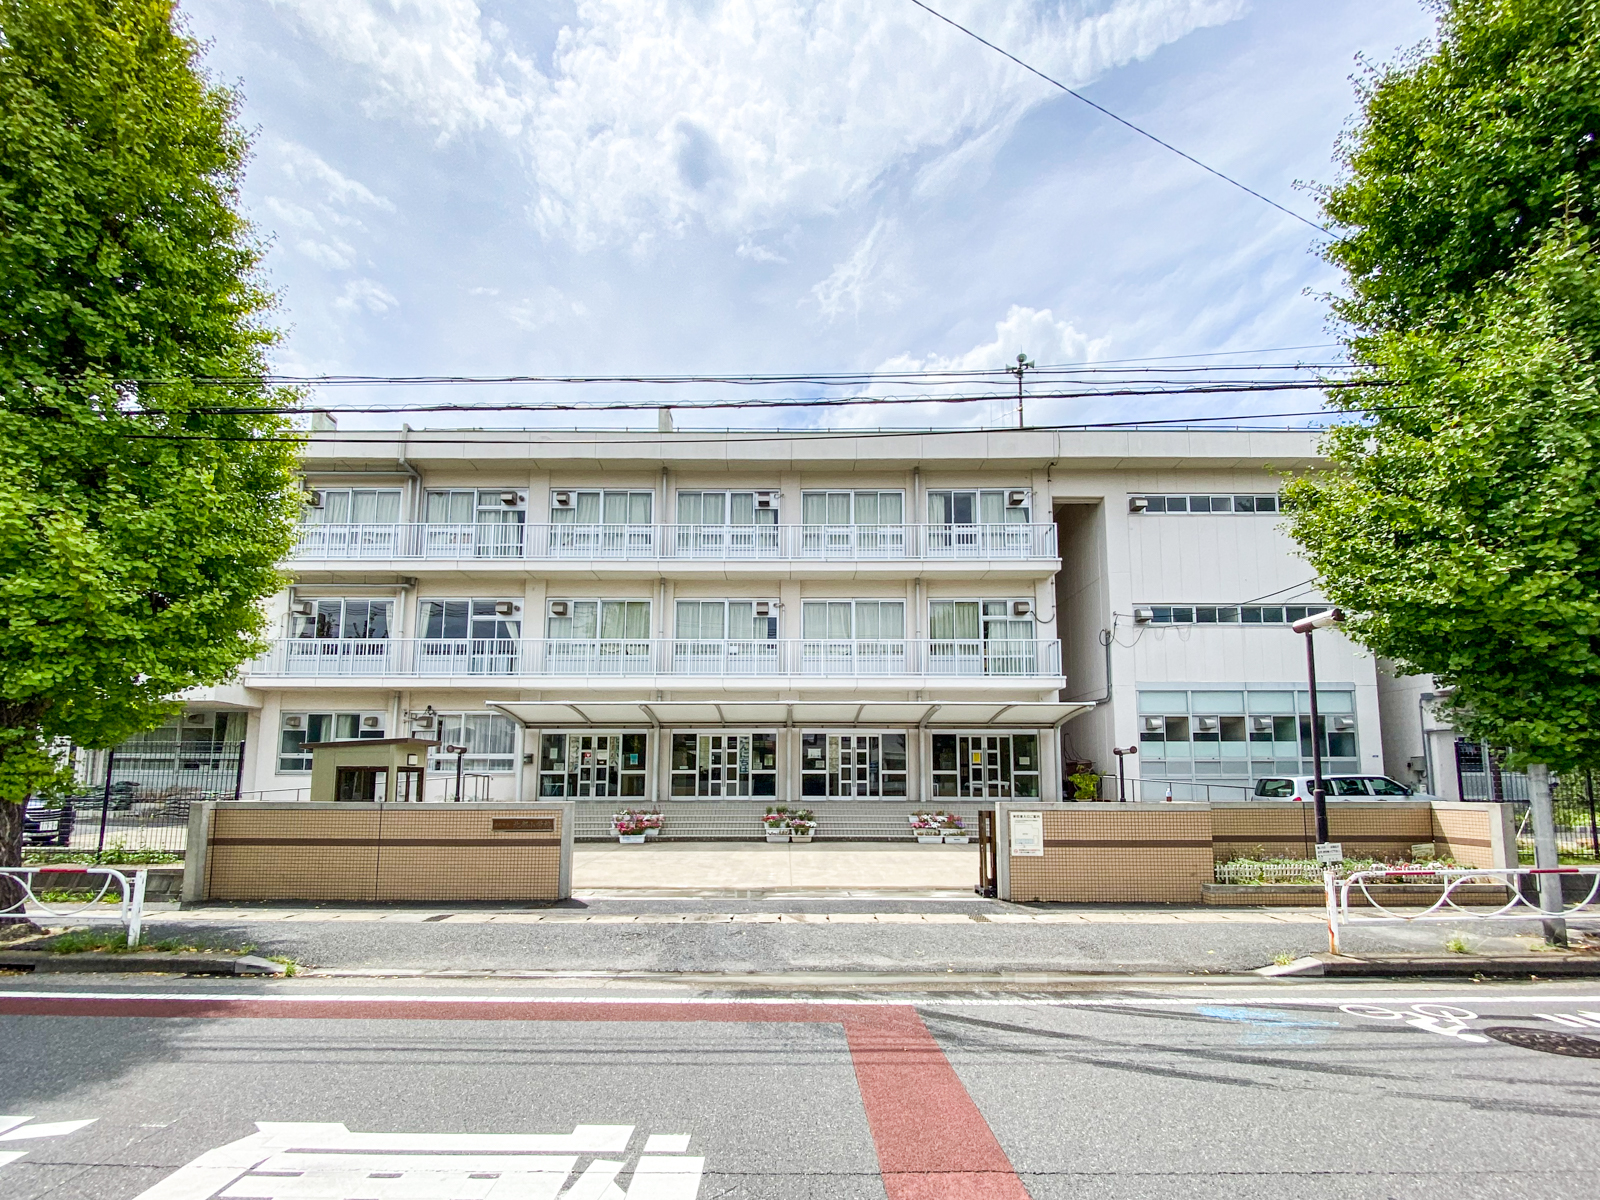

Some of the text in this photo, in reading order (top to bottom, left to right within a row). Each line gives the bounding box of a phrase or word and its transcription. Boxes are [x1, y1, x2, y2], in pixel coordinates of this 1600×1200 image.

[739, 736, 749, 773] こんにちは
